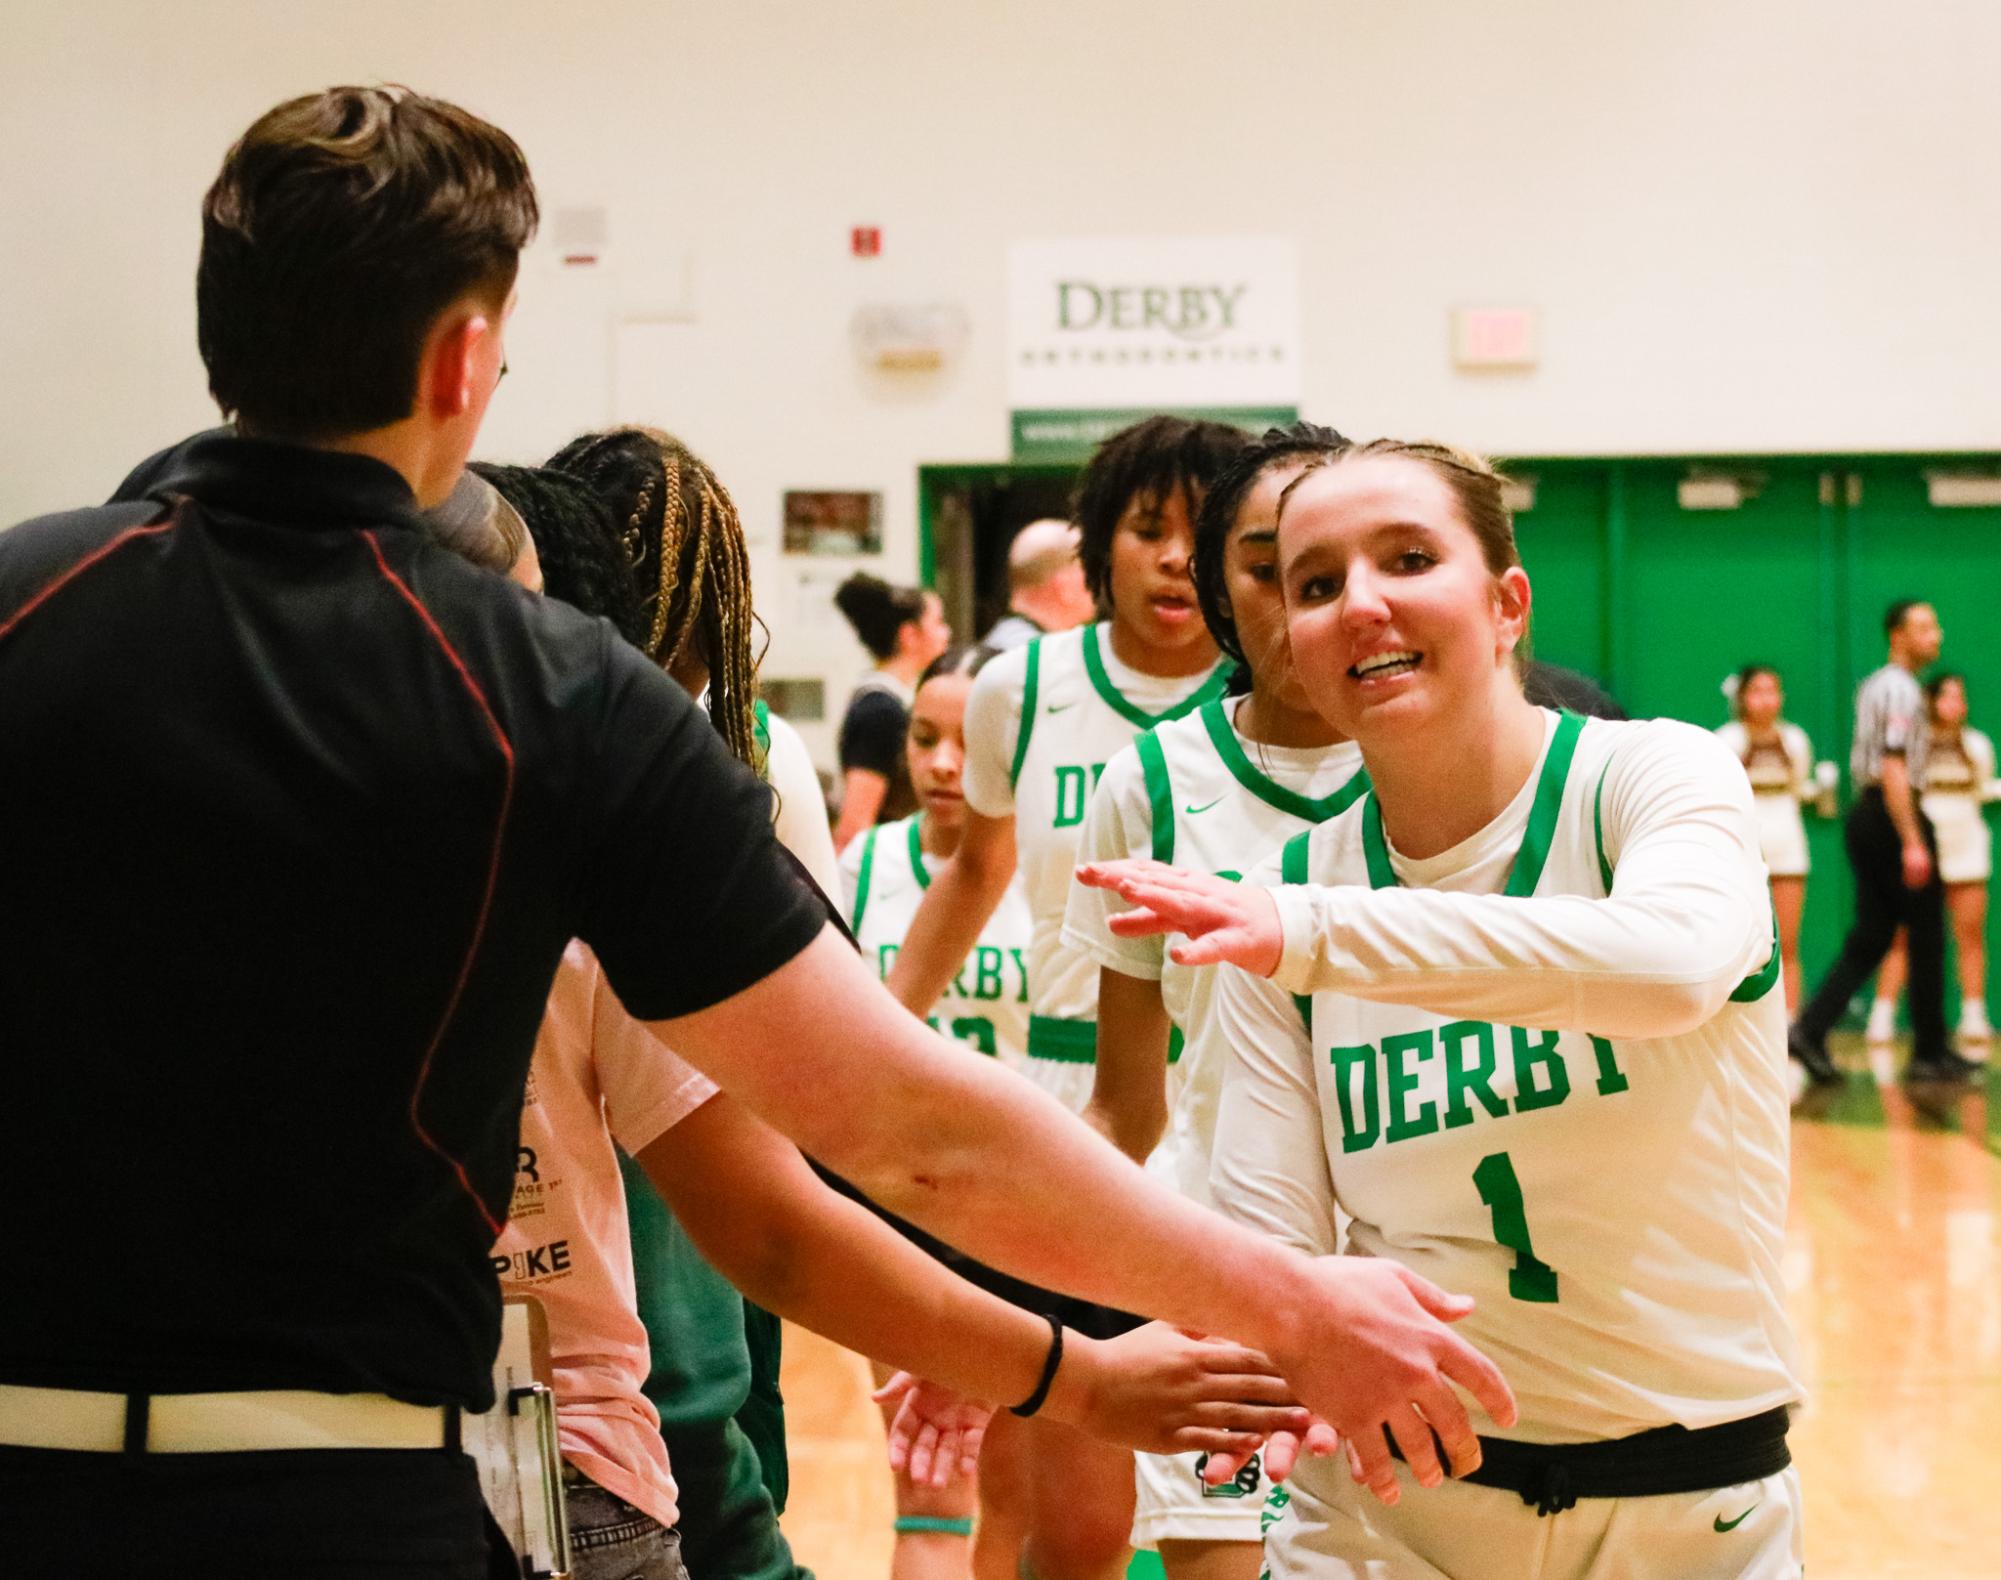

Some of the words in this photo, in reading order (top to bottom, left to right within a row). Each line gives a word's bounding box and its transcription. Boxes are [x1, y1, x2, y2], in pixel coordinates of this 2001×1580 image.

[1056, 280, 1246, 341] DERBY
[1053, 763, 1106, 828] D
[1330, 1020, 1629, 1154] DERBY
[1472, 1151, 1559, 1303] 1
